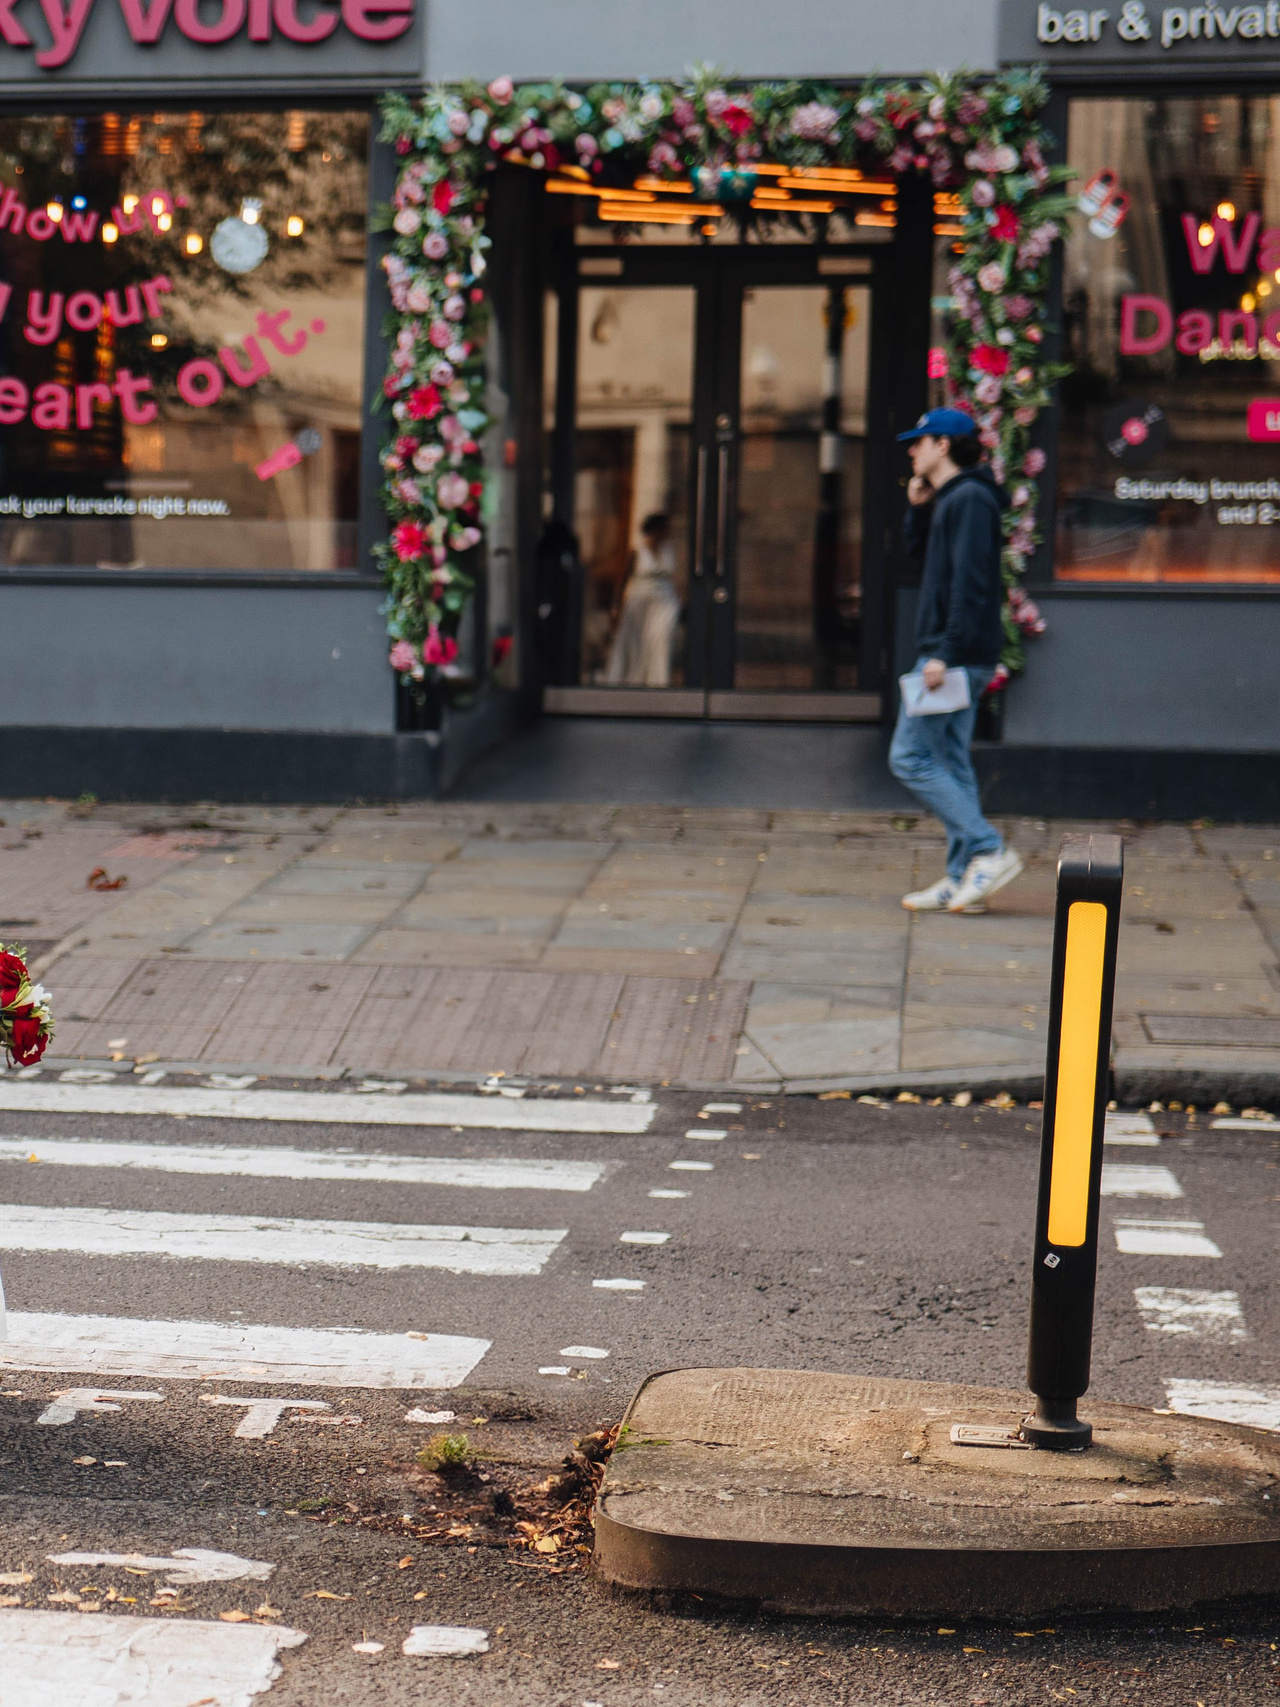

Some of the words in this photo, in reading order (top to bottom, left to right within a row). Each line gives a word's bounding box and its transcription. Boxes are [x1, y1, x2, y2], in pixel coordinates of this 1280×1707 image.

[119, 0, 412, 43] voice
[1037, 2, 1110, 43] bar
[1117, 0, 1151, 41] &
[24, 275, 174, 347] your
[177, 309, 326, 408] out.
[22, 498, 65, 519] your
[67, 494, 136, 515] karaoke
[138, 495, 186, 520] night
[1115, 476, 1209, 505] Saturday
[1217, 503, 1256, 524] and
